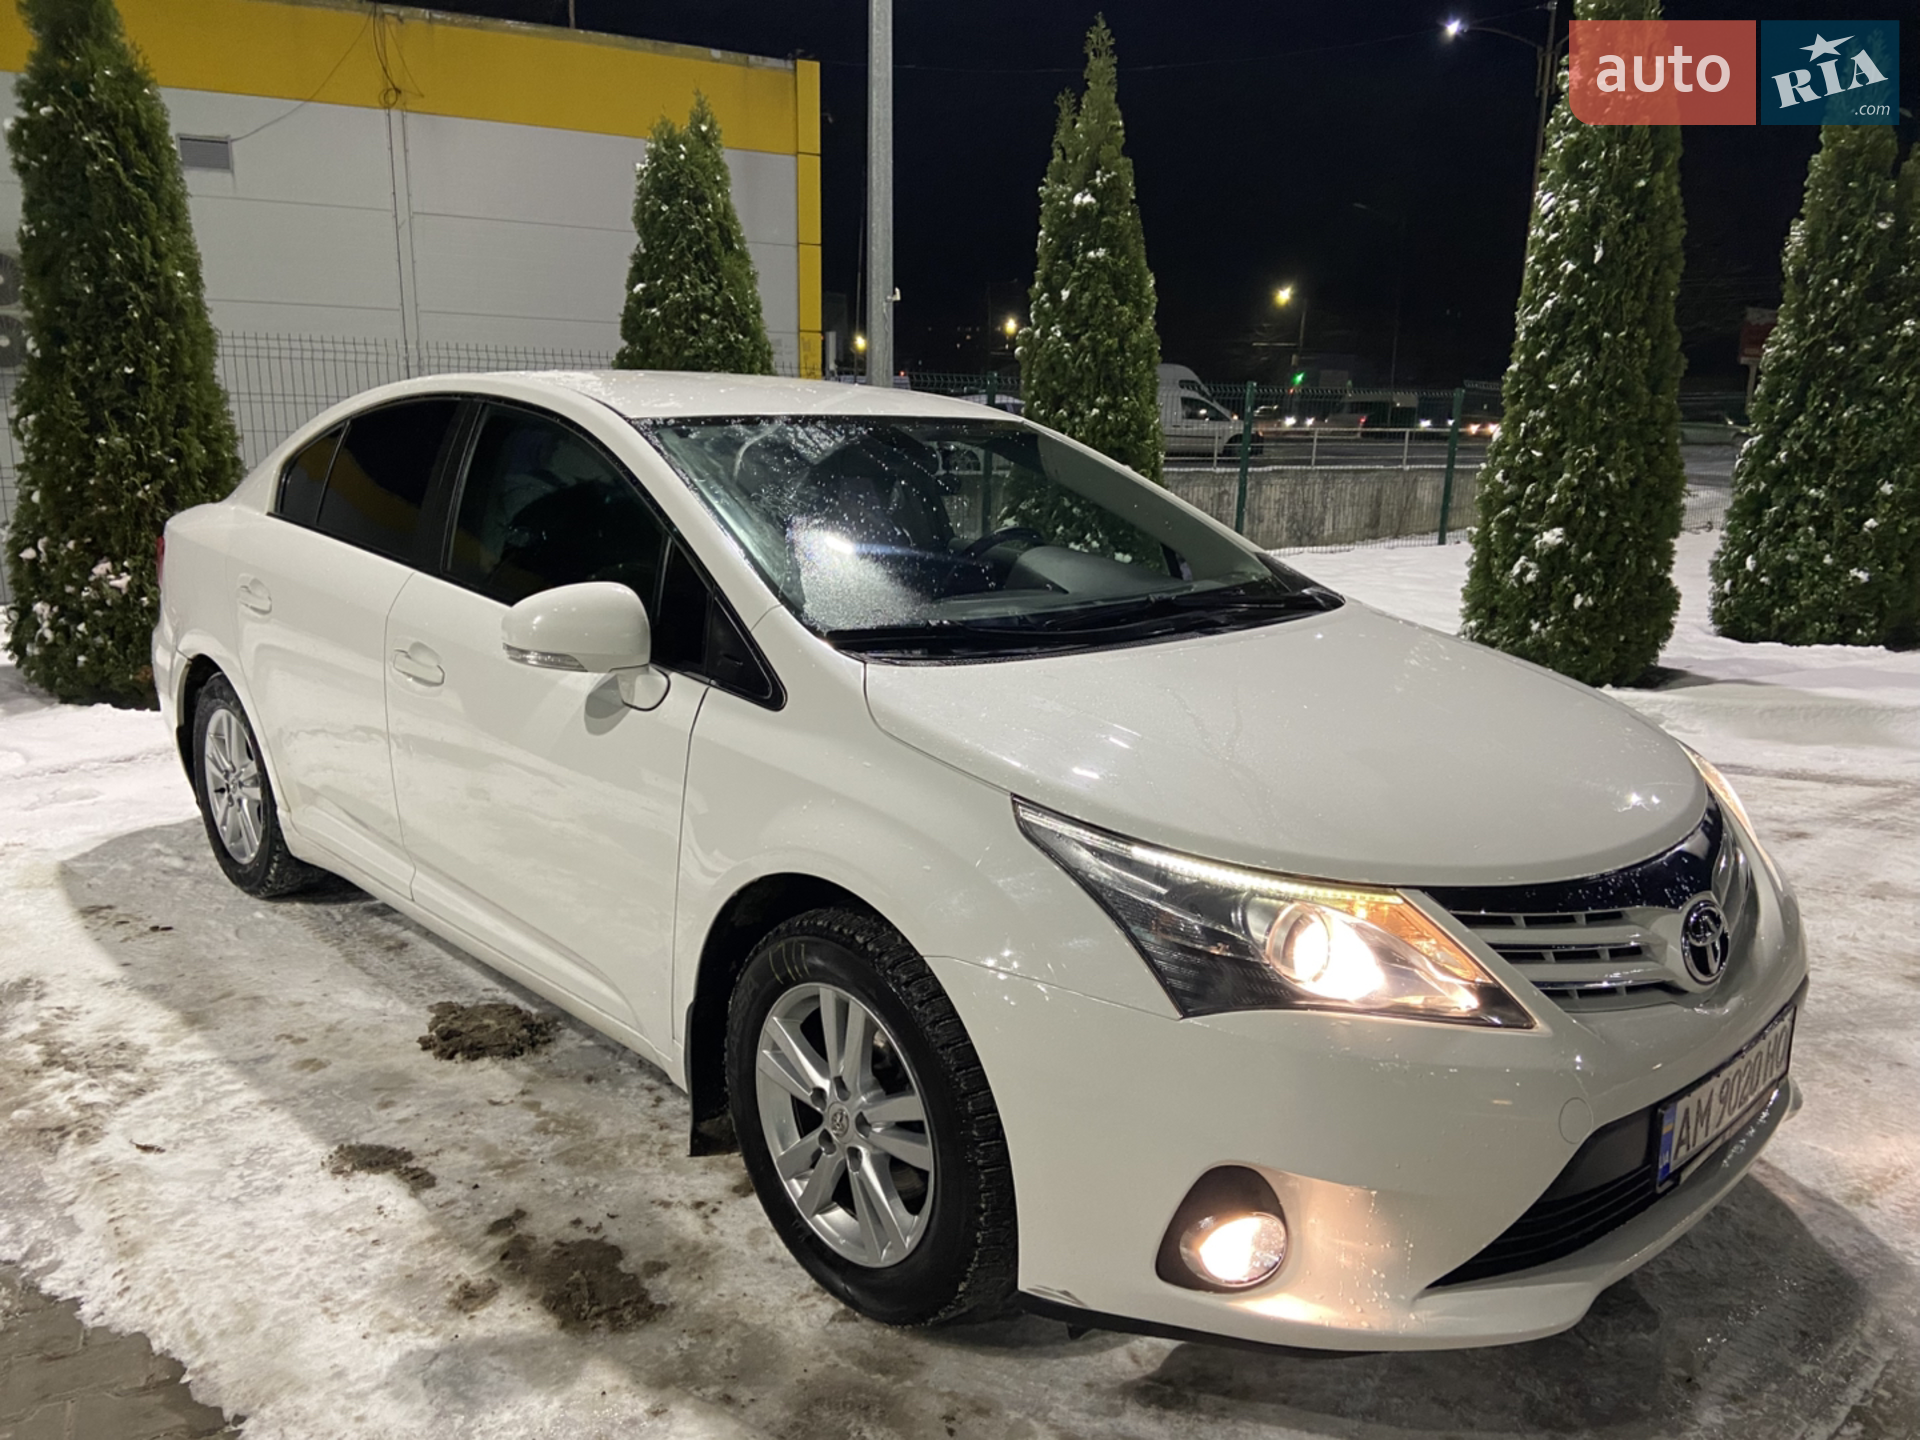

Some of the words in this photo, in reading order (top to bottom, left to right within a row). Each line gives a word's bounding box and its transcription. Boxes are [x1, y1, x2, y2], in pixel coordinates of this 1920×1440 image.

[1673, 1087, 1714, 1161] AM
[1715, 1051, 1763, 1129] 9020
[1763, 1024, 1789, 1083] HO
